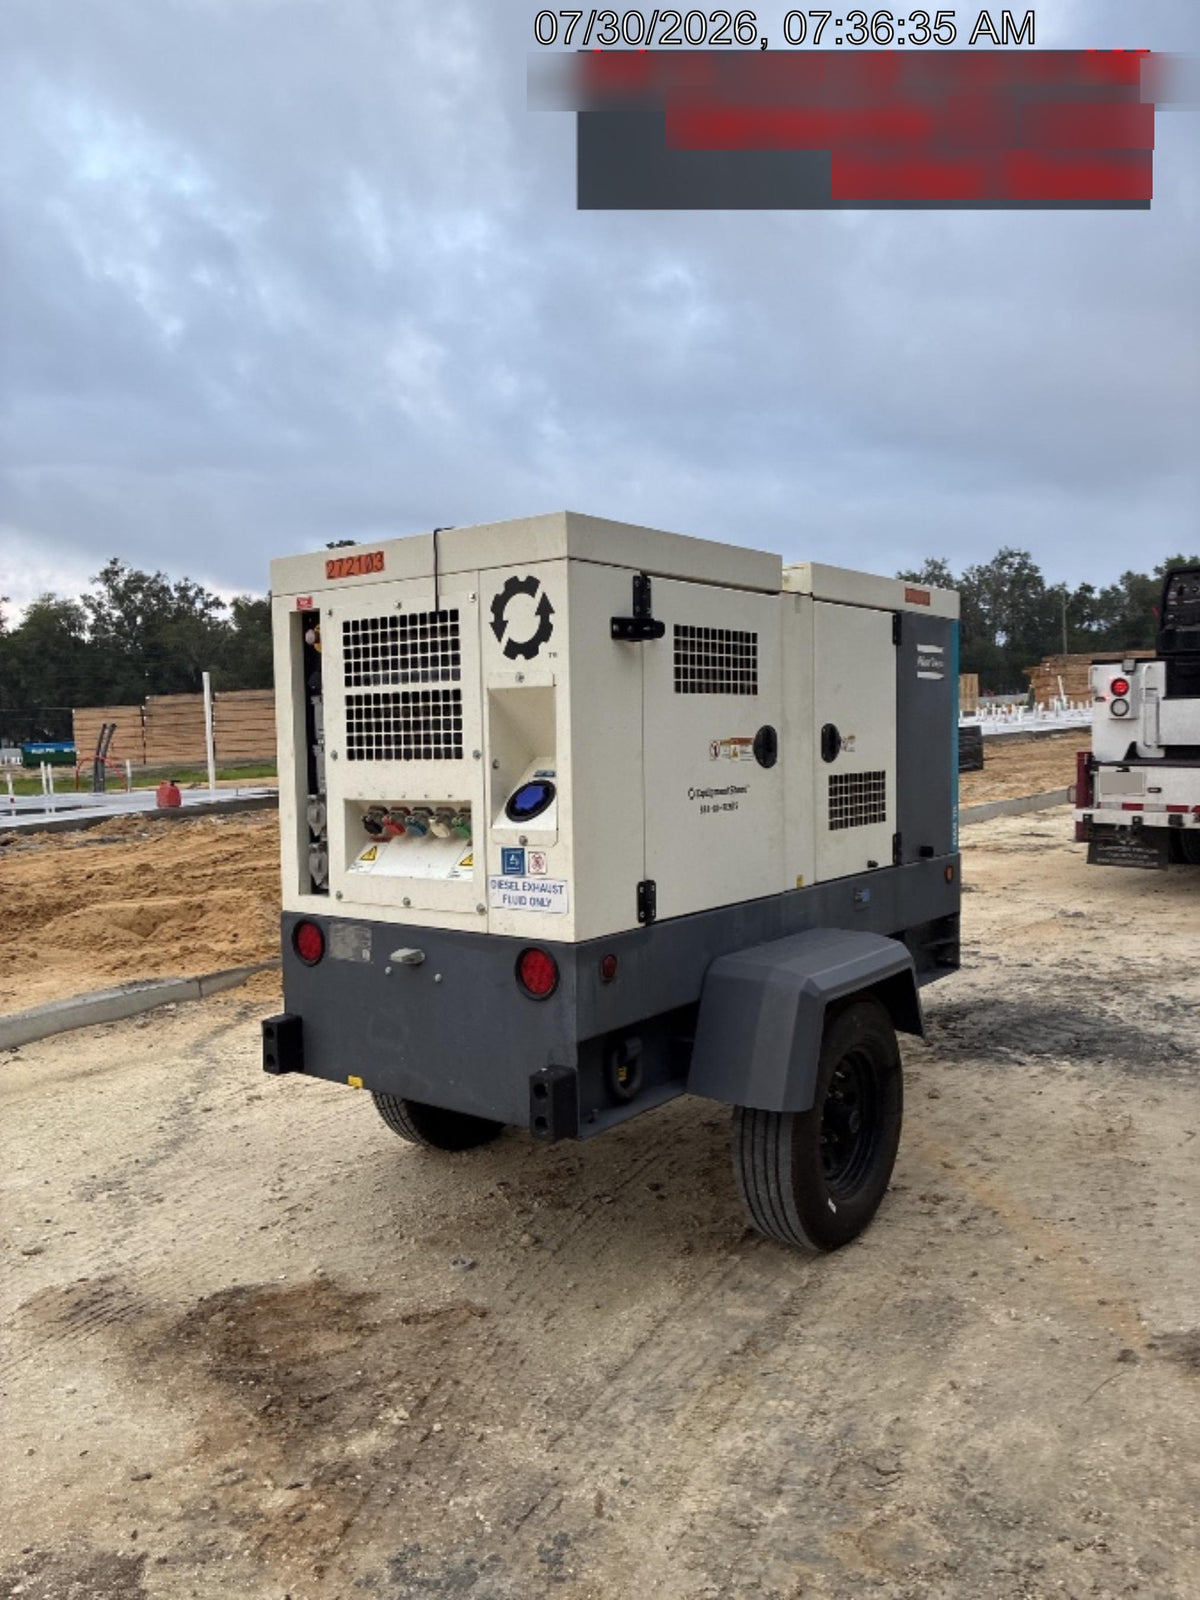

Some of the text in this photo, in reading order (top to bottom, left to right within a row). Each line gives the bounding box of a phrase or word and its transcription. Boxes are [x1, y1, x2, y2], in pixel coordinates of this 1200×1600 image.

[490, 880, 564, 895] DIESEL EXHAUST
[502, 894, 552, 907] FLUID ONLY
